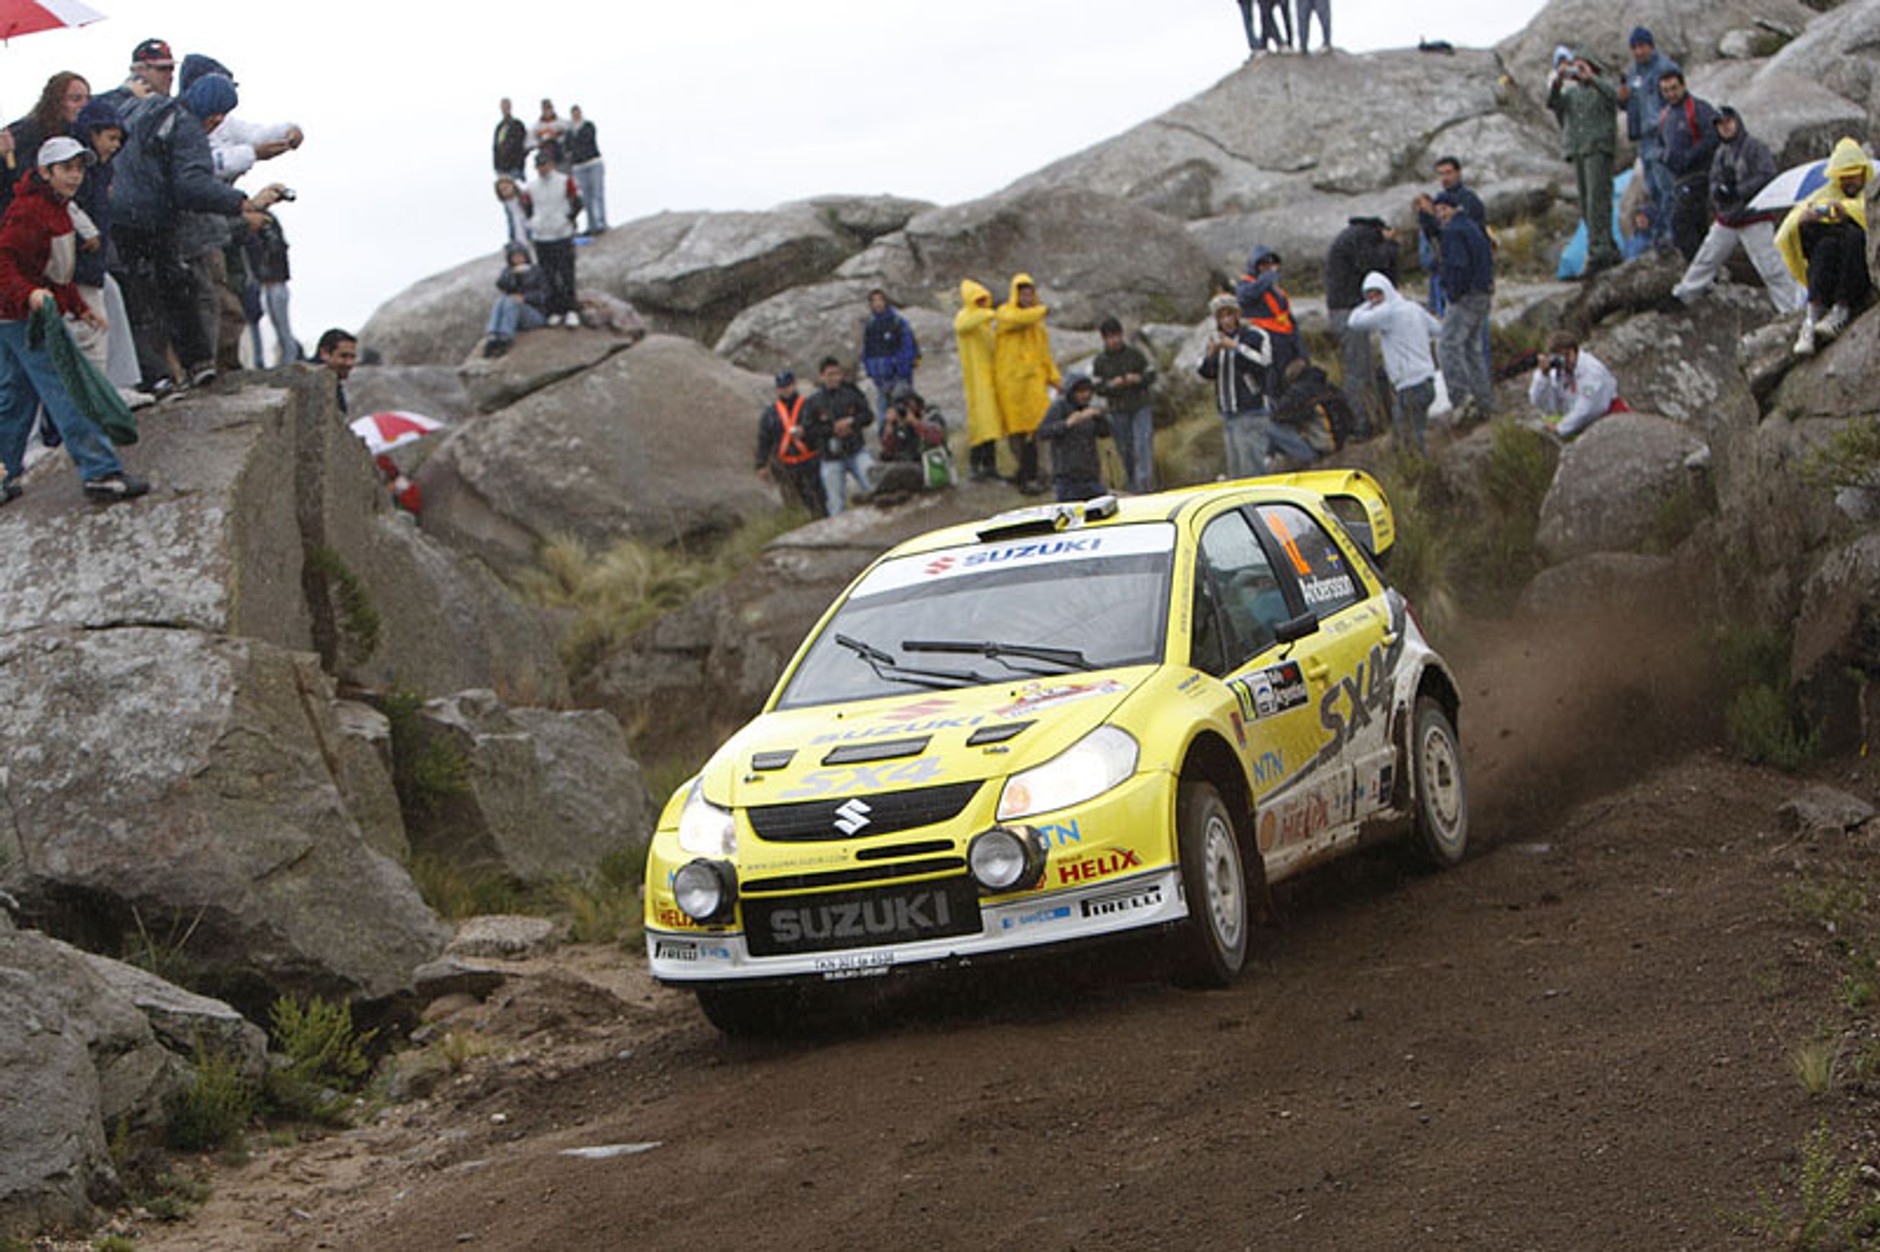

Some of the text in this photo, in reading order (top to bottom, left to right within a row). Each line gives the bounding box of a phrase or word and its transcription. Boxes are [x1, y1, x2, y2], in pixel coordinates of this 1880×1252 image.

[964, 537, 1102, 567] SUZUKI
[1297, 574, 1356, 605] Andersson
[1320, 643, 1397, 745] SX4
[810, 715, 985, 746] SUZUKI
[780, 756, 946, 798] SX4
[1253, 748, 1283, 786] NTN
[1039, 820, 1081, 848] TN
[1058, 849, 1140, 884] HELIX
[771, 892, 952, 942] SUZUKI
[1080, 885, 1162, 918] PIRELLI
[654, 942, 697, 961] PIRELLI
